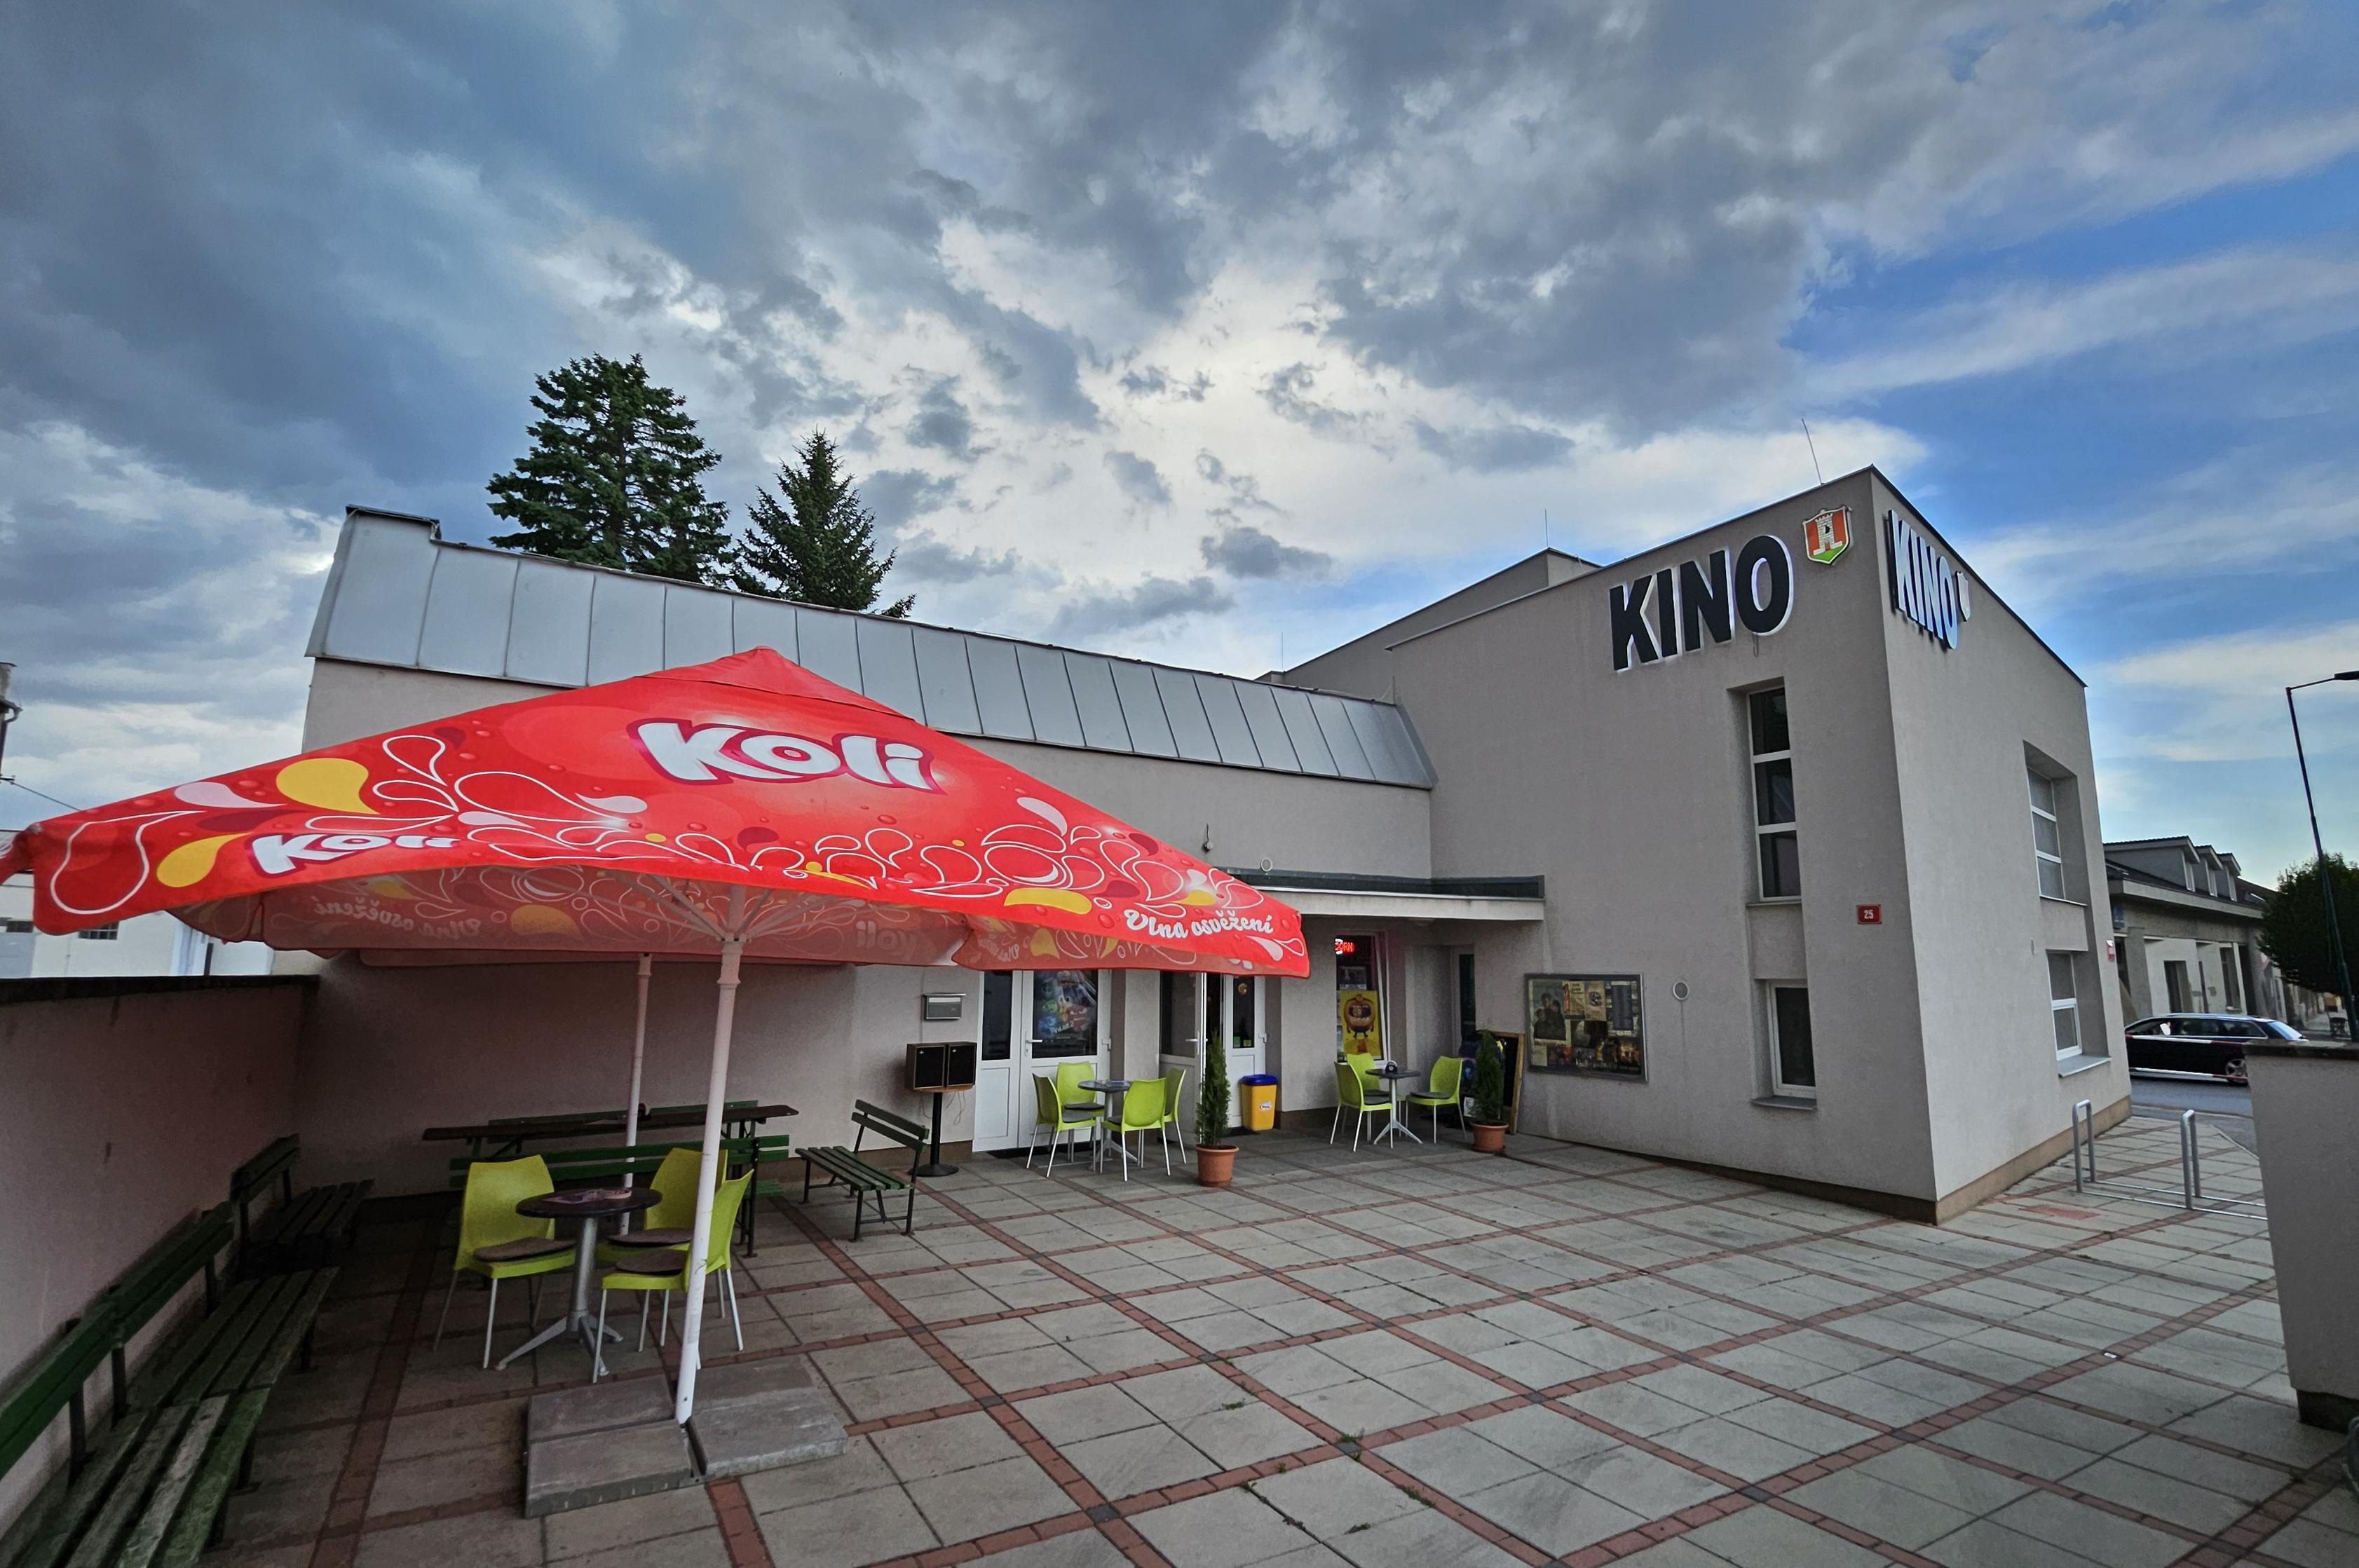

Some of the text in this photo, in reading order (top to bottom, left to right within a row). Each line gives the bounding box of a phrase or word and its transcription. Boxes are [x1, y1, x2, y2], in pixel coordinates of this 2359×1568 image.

[1610, 535, 1793, 673] KINO
[1889, 510, 1958, 650] KINO
[631, 721, 941, 792] Koli
[1123, 908, 1274, 939] Vlna osvěžení
[1863, 909, 1874, 920] 25
